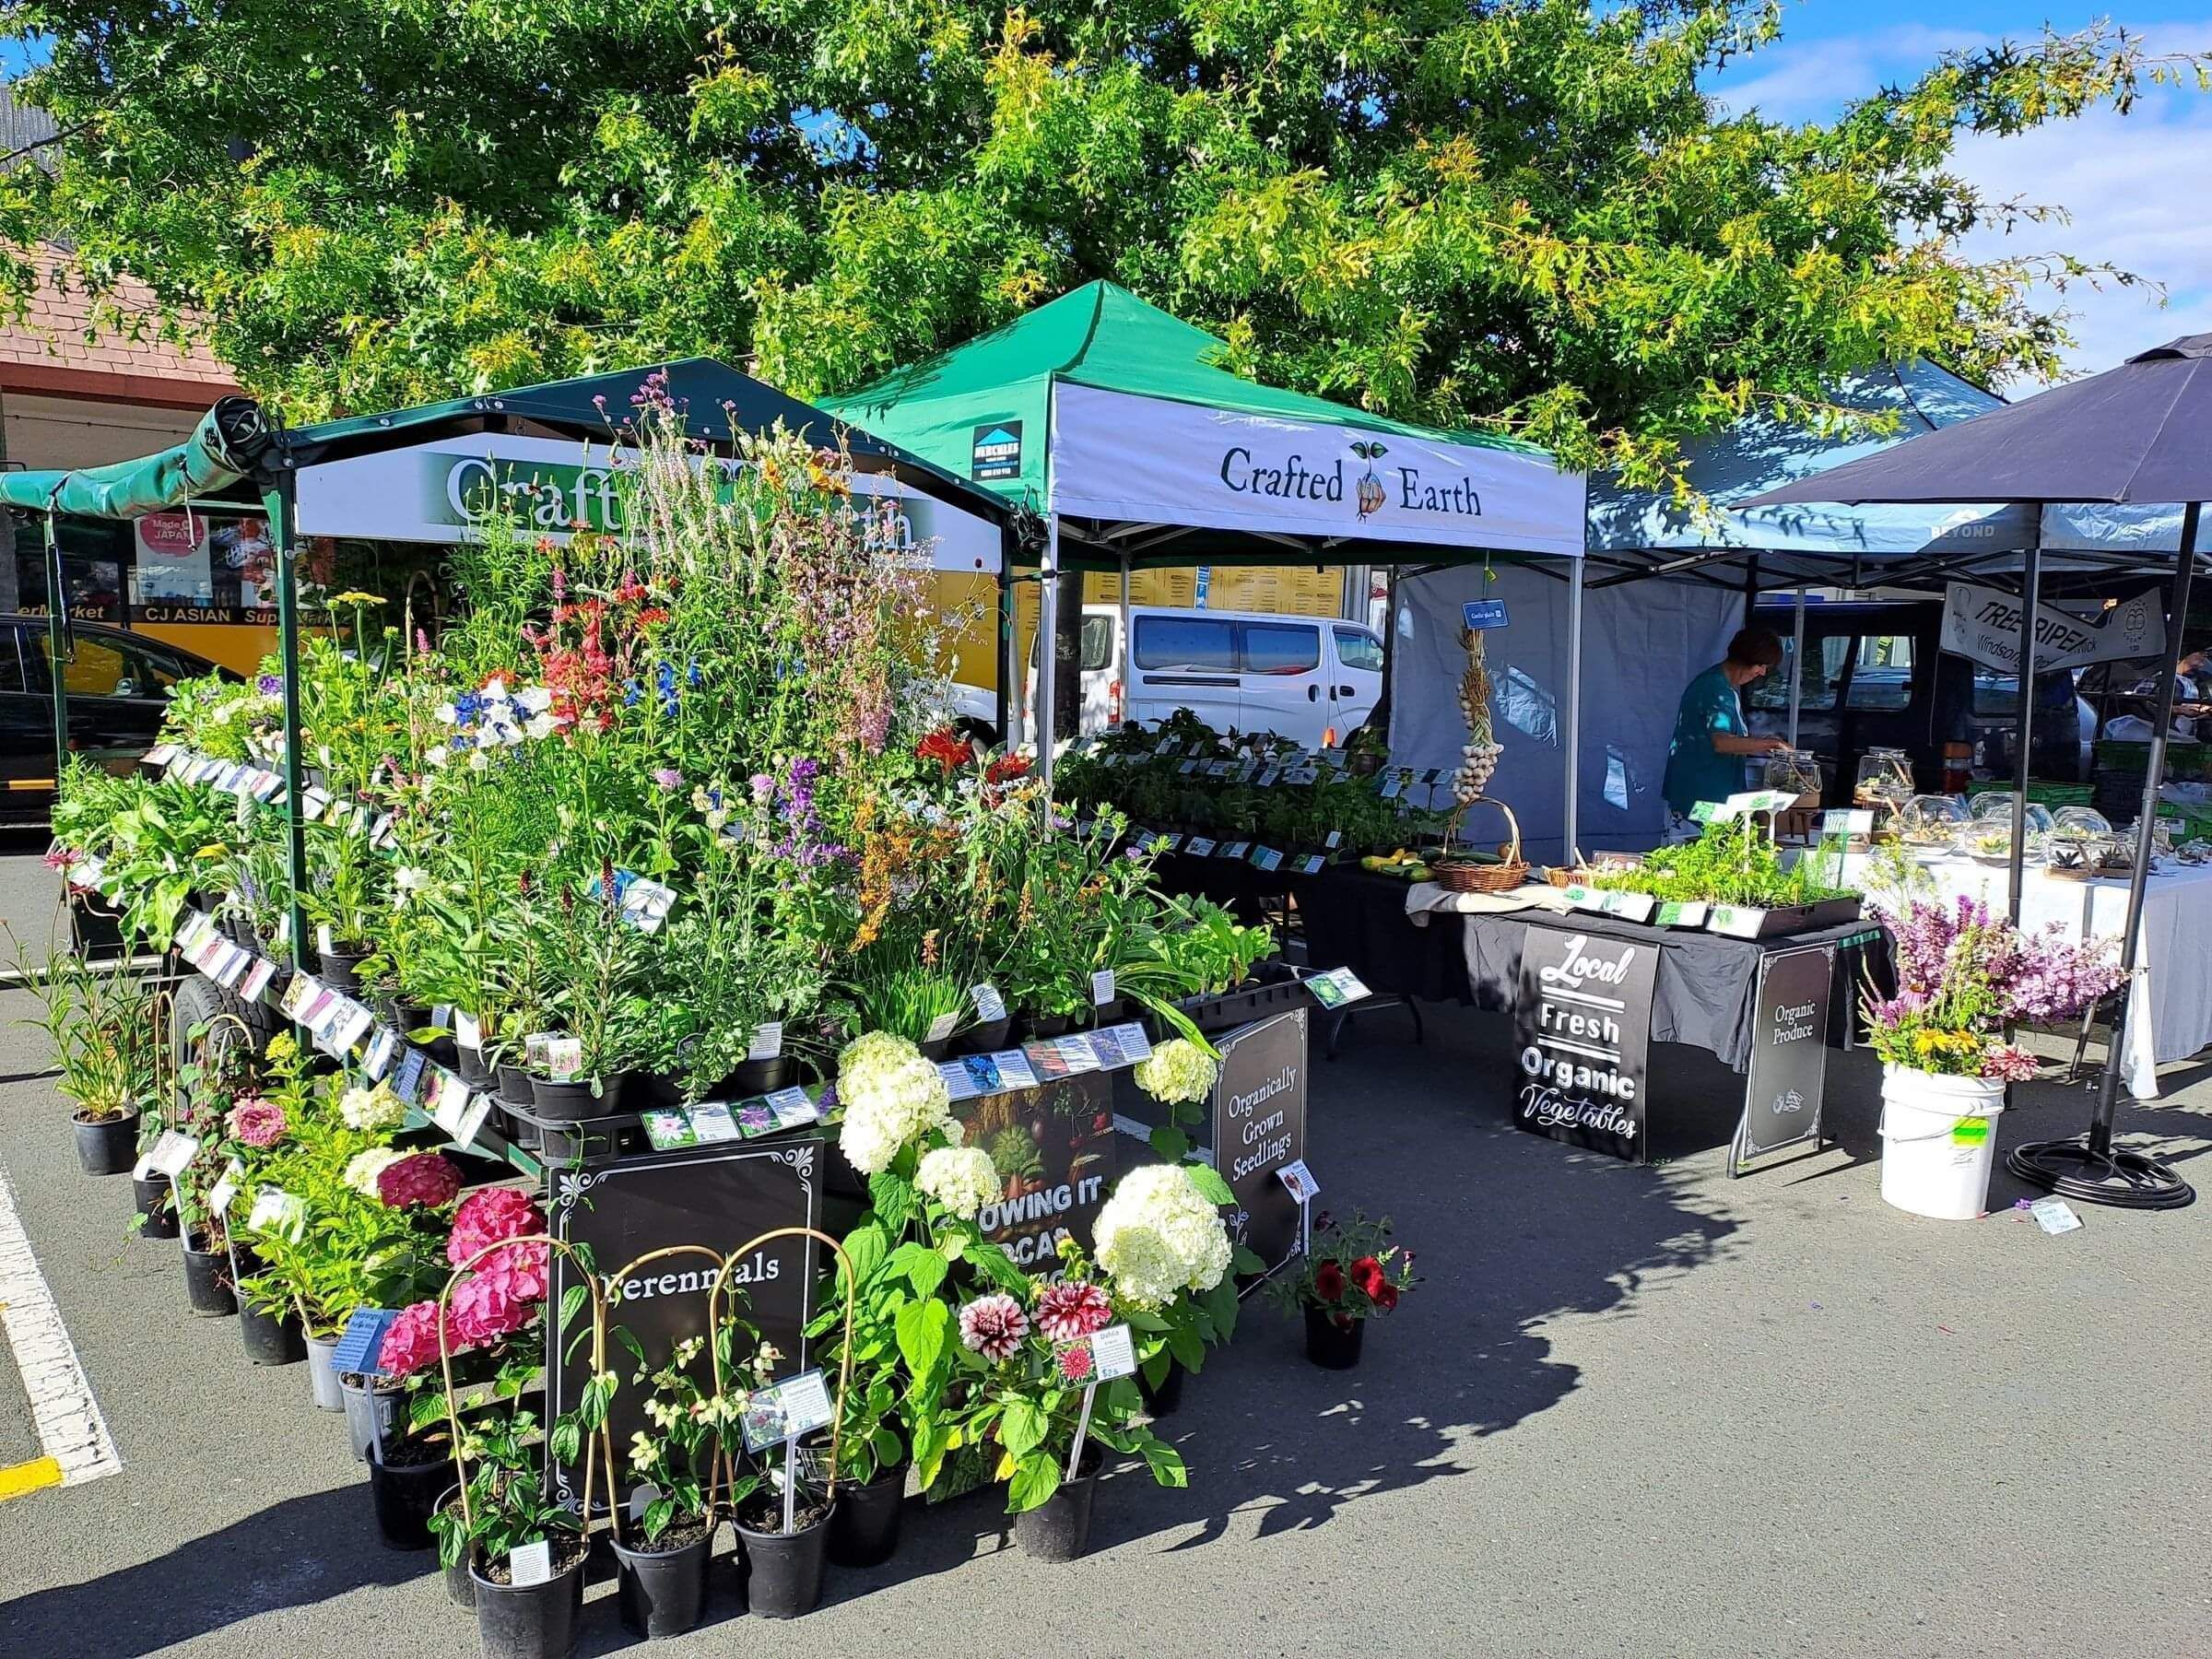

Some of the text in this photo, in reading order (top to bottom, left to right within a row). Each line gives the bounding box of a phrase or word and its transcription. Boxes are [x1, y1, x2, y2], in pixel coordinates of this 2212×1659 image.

[1220, 447, 1482, 516] Crafted Earth
[1931, 525, 1995, 538] BEYOND
[146, 608, 169, 621] CJ
[175, 608, 230, 621] ASIAN
[1540, 935, 1636, 988] Local
[1540, 1003, 1620, 1044] Fresh
[1772, 1023, 1813, 1045] Produce
[1774, 999, 1816, 1025] Organic
[1229, 1065, 1297, 1119] Organically
[1521, 1046, 1636, 1100] Organic
[1242, 1109, 1284, 1146] Grown
[1520, 1083, 1638, 1139] Vegetables
[1233, 1132, 1292, 1182] Seedlings
[979, 1175, 1103, 1233] OWING IT
[600, 1252, 780, 1303] erennals
